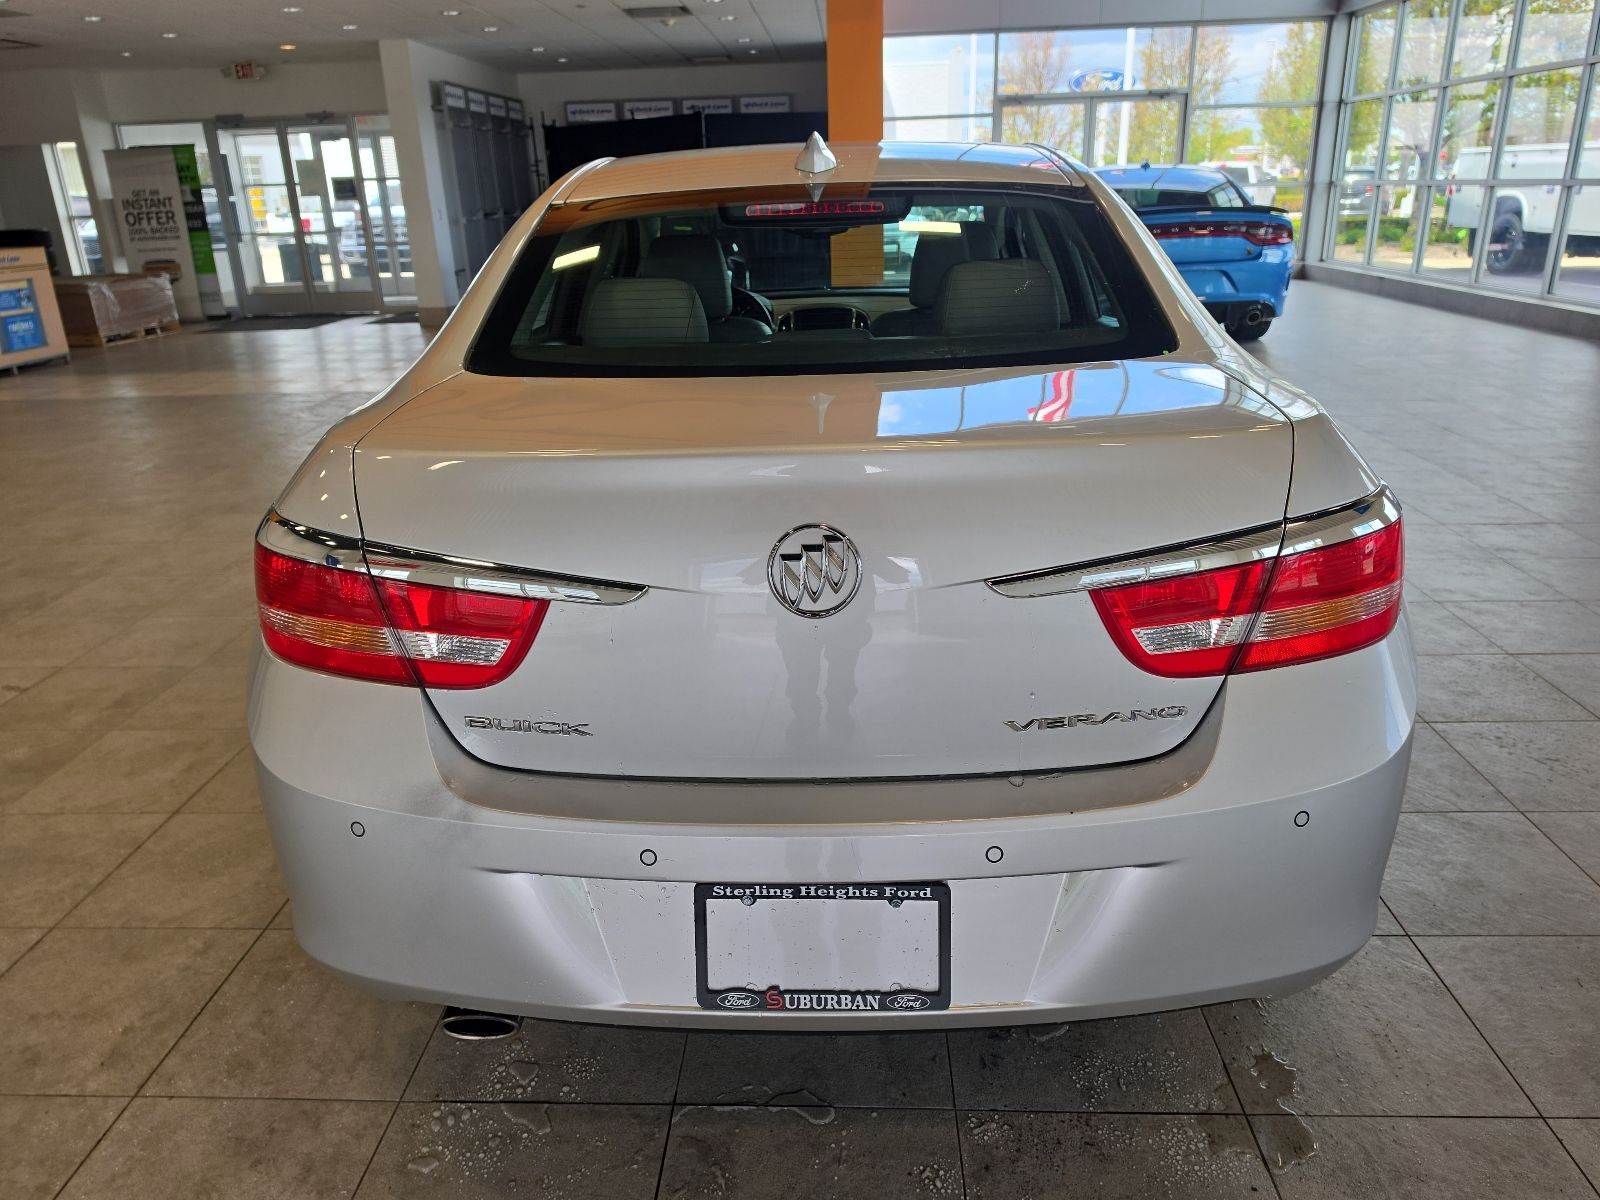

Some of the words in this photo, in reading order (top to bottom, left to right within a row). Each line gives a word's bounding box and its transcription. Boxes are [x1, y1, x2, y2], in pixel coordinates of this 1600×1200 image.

[131, 189, 147, 198] GET
[122, 197, 173, 211] INSTANT
[125, 210, 177, 227] OFFER
[464, 716, 593, 737] BUICK
[1003, 705, 1188, 733] VERANO
[712, 885, 794, 899] Sterling
[799, 885, 878, 899] Heights
[883, 886, 932, 898] Ford
[724, 992, 752, 1007] Ford
[765, 989, 881, 1010] SUBURBAN
[894, 994, 922, 1009] Ford
